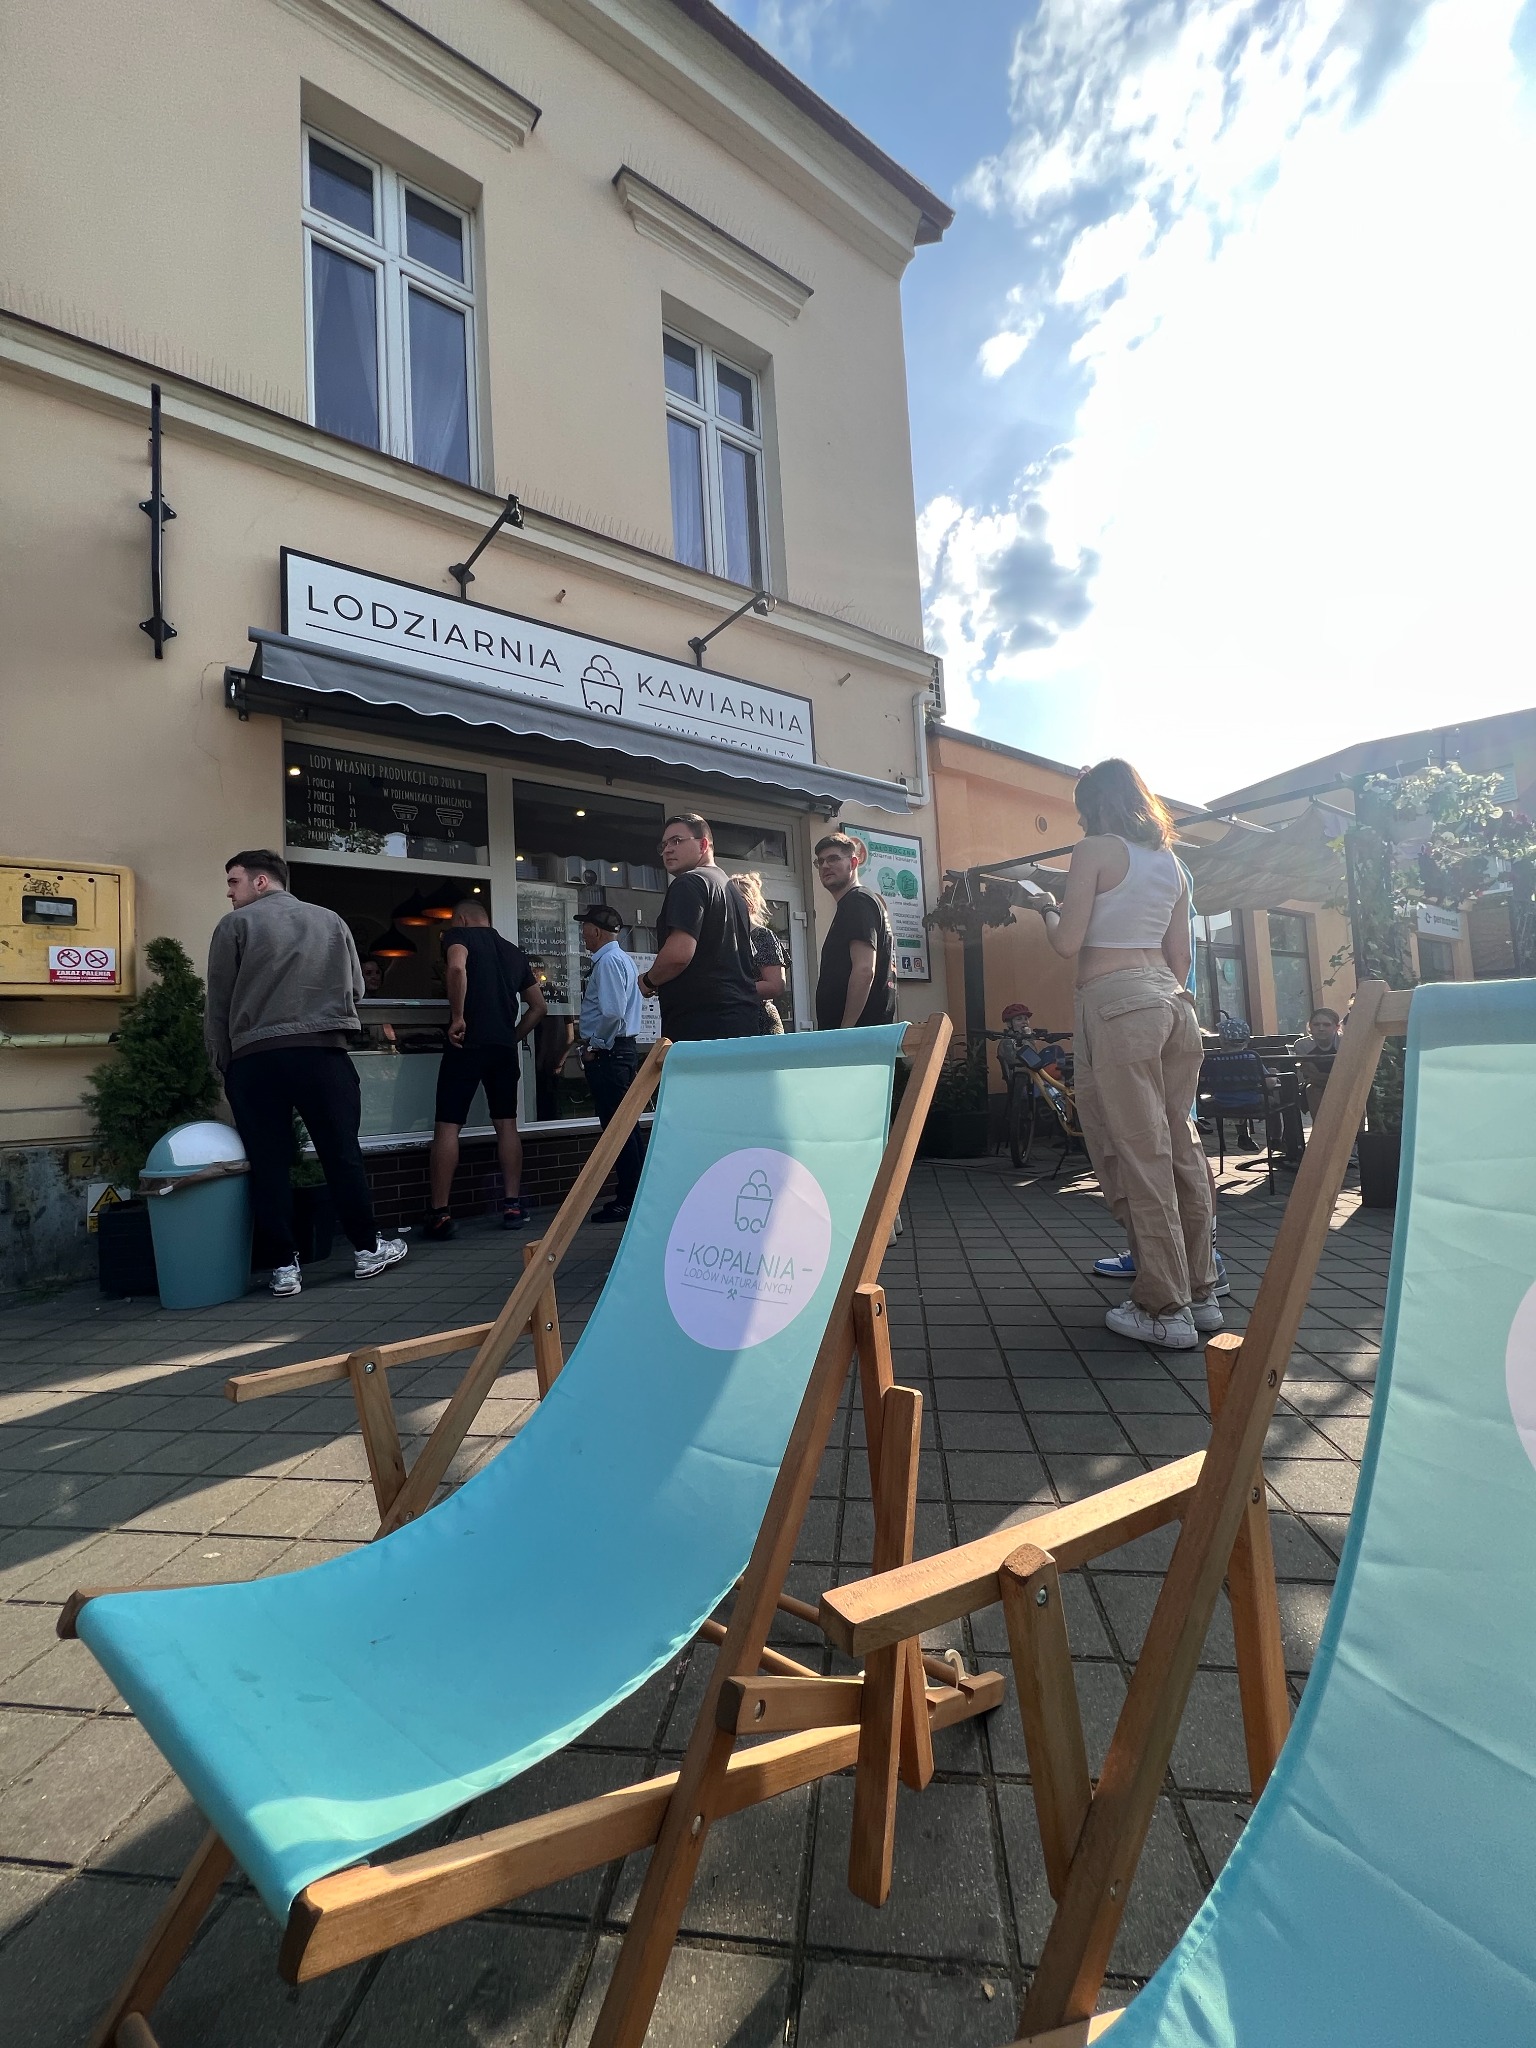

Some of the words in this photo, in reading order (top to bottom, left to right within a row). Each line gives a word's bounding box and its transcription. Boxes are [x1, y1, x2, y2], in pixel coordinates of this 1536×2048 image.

[307, 584, 562, 674] LODZIARNIA
[637, 672, 804, 735] KAWIARNIA
[309, 753, 332, 771] LODY
[335, 758, 376, 778] WŁASNEJ
[379, 765, 427, 786] PRODUKCJI
[429, 775, 439, 787] OD
[312, 777, 335, 790] PORCJA
[313, 790, 335, 804] PORCJE
[313, 803, 336, 817] PORCJE
[313, 816, 336, 831] PORCJE
[688, 1242, 795, 1280] KOPALNIA
[683, 1266, 719, 1283] LODÓW
[720, 1274, 792, 1295] NATURALNYCH
